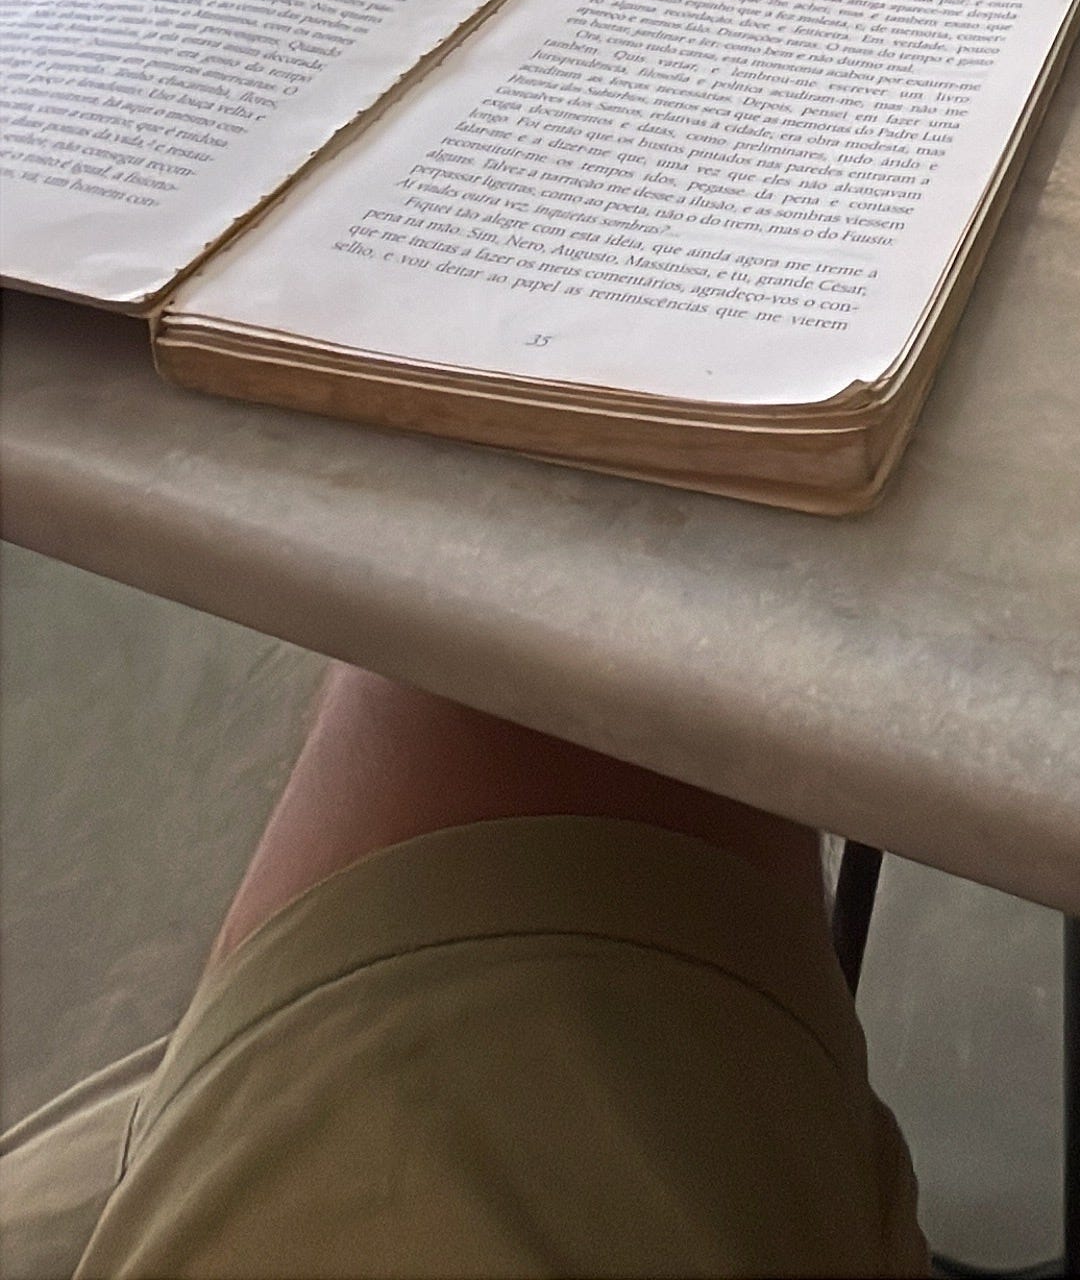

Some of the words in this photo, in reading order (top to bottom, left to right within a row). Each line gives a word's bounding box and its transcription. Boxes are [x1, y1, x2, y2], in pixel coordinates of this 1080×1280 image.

[440, 136, 549, 164] reconstituir-me
[555, 158, 575, 169] os
[578, 162, 636, 179] tempos
[685, 180, 746, 197] pegasse
[753, 187, 774, 200] da
[780, 194, 820, 206] pena
[848, 201, 915, 216] contasse
[453, 120, 513, 140] falar-me
[547, 137, 613, 158] dizer-me
[655, 159, 690, 171] uma
[696, 165, 723, 178] vez
[725, 170, 757, 183] que
[761, 173, 793, 187] eles
[797, 179, 829, 191] não
[832, 181, 923, 201] alcançavam
[515, 115, 543, 129] Foi
[542, 123, 583, 137] então
[584, 130, 614, 142] que
[615, 136, 636, 146] os
[636, 136, 687, 155] bustos
[686, 148, 755, 167] pintados
[754, 159, 784, 171] nas
[783, 163, 845, 177] paredes
[847, 170, 917, 185] entraram
[408, 164, 483, 184] perpassar
[539, 189, 584, 205] como
[583, 197, 605, 208] ao
[653, 208, 685, 221] não
[698, 213, 722, 226] do
[766, 224, 801, 236] mas
[816, 226, 839, 240] do
[481, 157, 528, 176] Talvez
[539, 171, 608, 190] narração
[605, 183, 632, 196] me
[631, 185, 676, 203] desse
[773, 209, 842, 224] sombras
[845, 215, 905, 231] viessem
[347, 224, 379, 239] que
[379, 230, 409, 244] me
[407, 235, 461, 255] incitas
[473, 246, 515, 265] fazer
[515, 258, 537, 270] os
[536, 261, 583, 277] meus
[689, 285, 800, 307] agradeço-vos
[818, 300, 860, 313] con-
[359, 208, 404, 224] pena
[402, 216, 426, 229] na
[753, 275, 815, 290] grande
[400, 195, 454, 215] Fiquei
[453, 207, 482, 221] tão
[480, 211, 531, 231] alegre
[531, 223, 567, 238] com
[568, 231, 602, 244] esta
[651, 243, 684, 257] que
[685, 248, 734, 262] ainda
[733, 254, 780, 269] agora
[783, 260, 812, 271] me
[814, 263, 864, 277] treme
[400, 254, 433, 269] vou
[433, 259, 484, 279] deitar
[485, 273, 509, 284] ao
[510, 277, 563, 293] papel
[587, 287, 710, 313] reminiscências
[715, 306, 750, 320] que
[753, 311, 783, 323] me
[791, 315, 849, 331] vierem
[524, 334, 553, 347] 35
